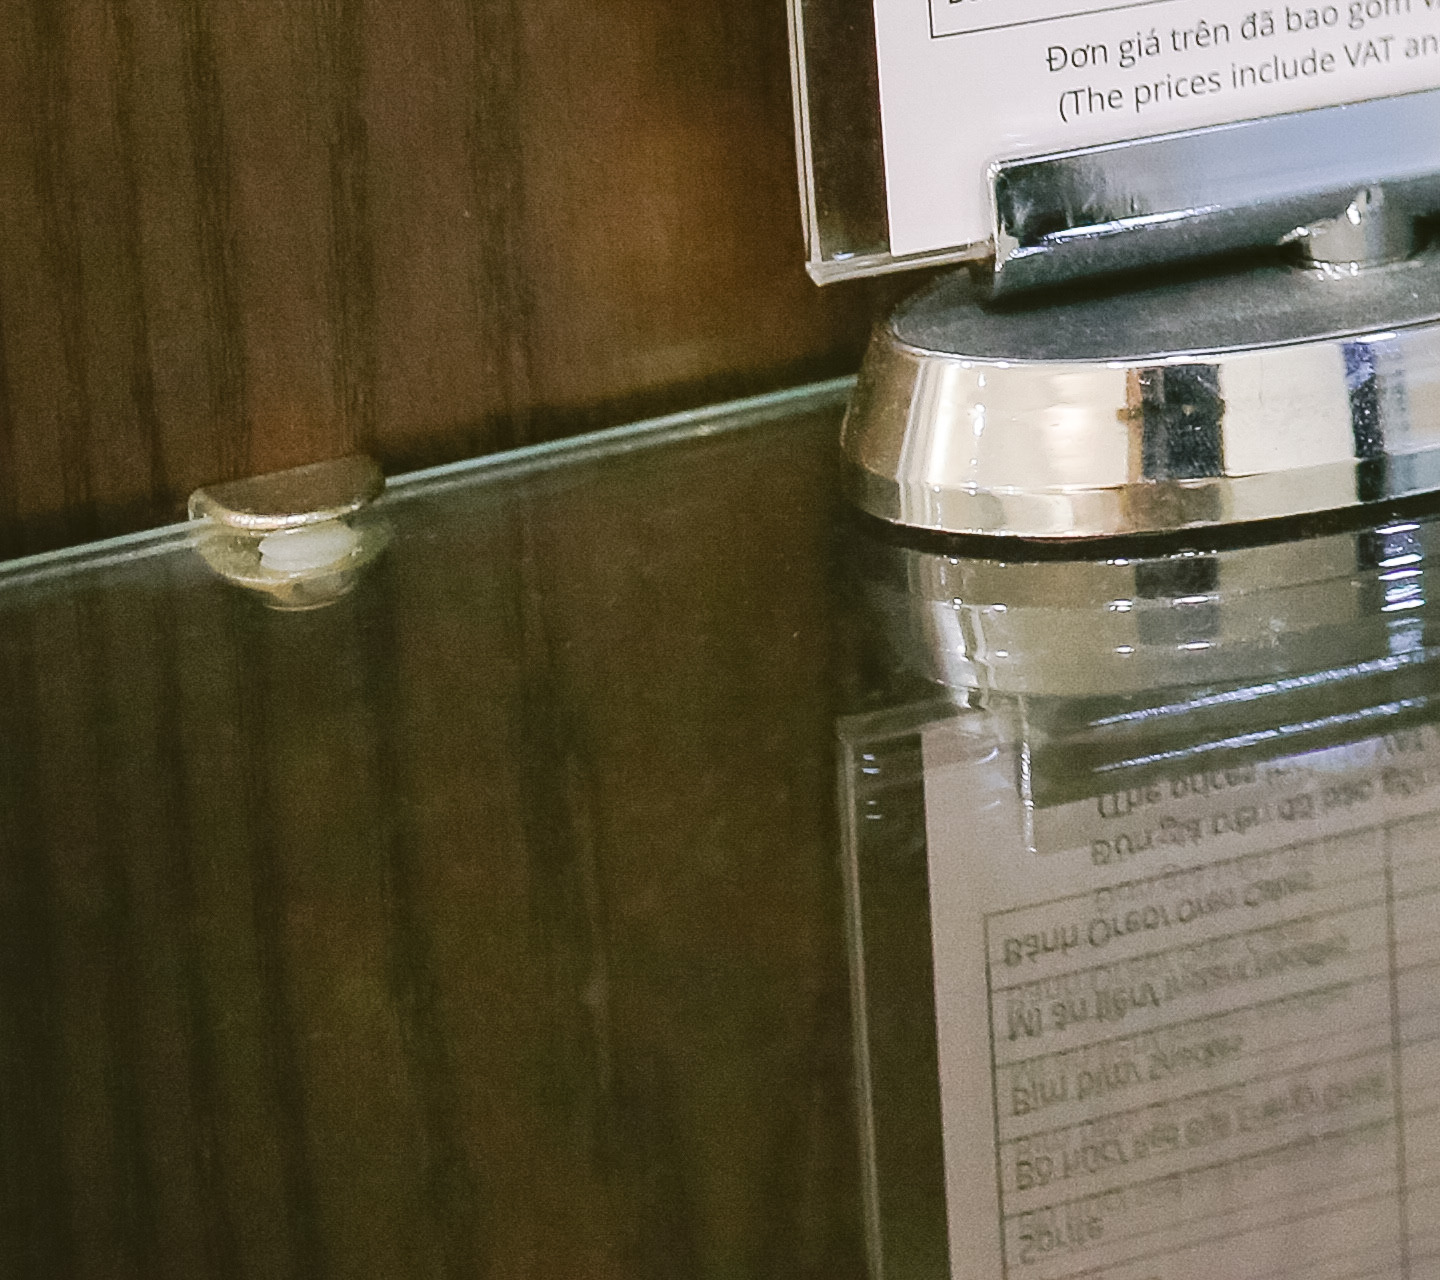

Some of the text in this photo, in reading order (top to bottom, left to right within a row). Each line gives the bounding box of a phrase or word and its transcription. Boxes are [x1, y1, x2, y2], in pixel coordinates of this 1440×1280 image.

[1046, 42, 1107, 73] Đơn
[1119, 28, 1160, 68] giá
[1172, 20, 1229, 52] trên
[1241, 8, 1275, 41] đã
[1286, 5, 1338, 32] bao
[1059, 88, 1123, 123] (The
[1135, 71, 1221, 113] prices
[1231, 49, 1335, 88] include
[1344, 35, 1394, 67] VAT
